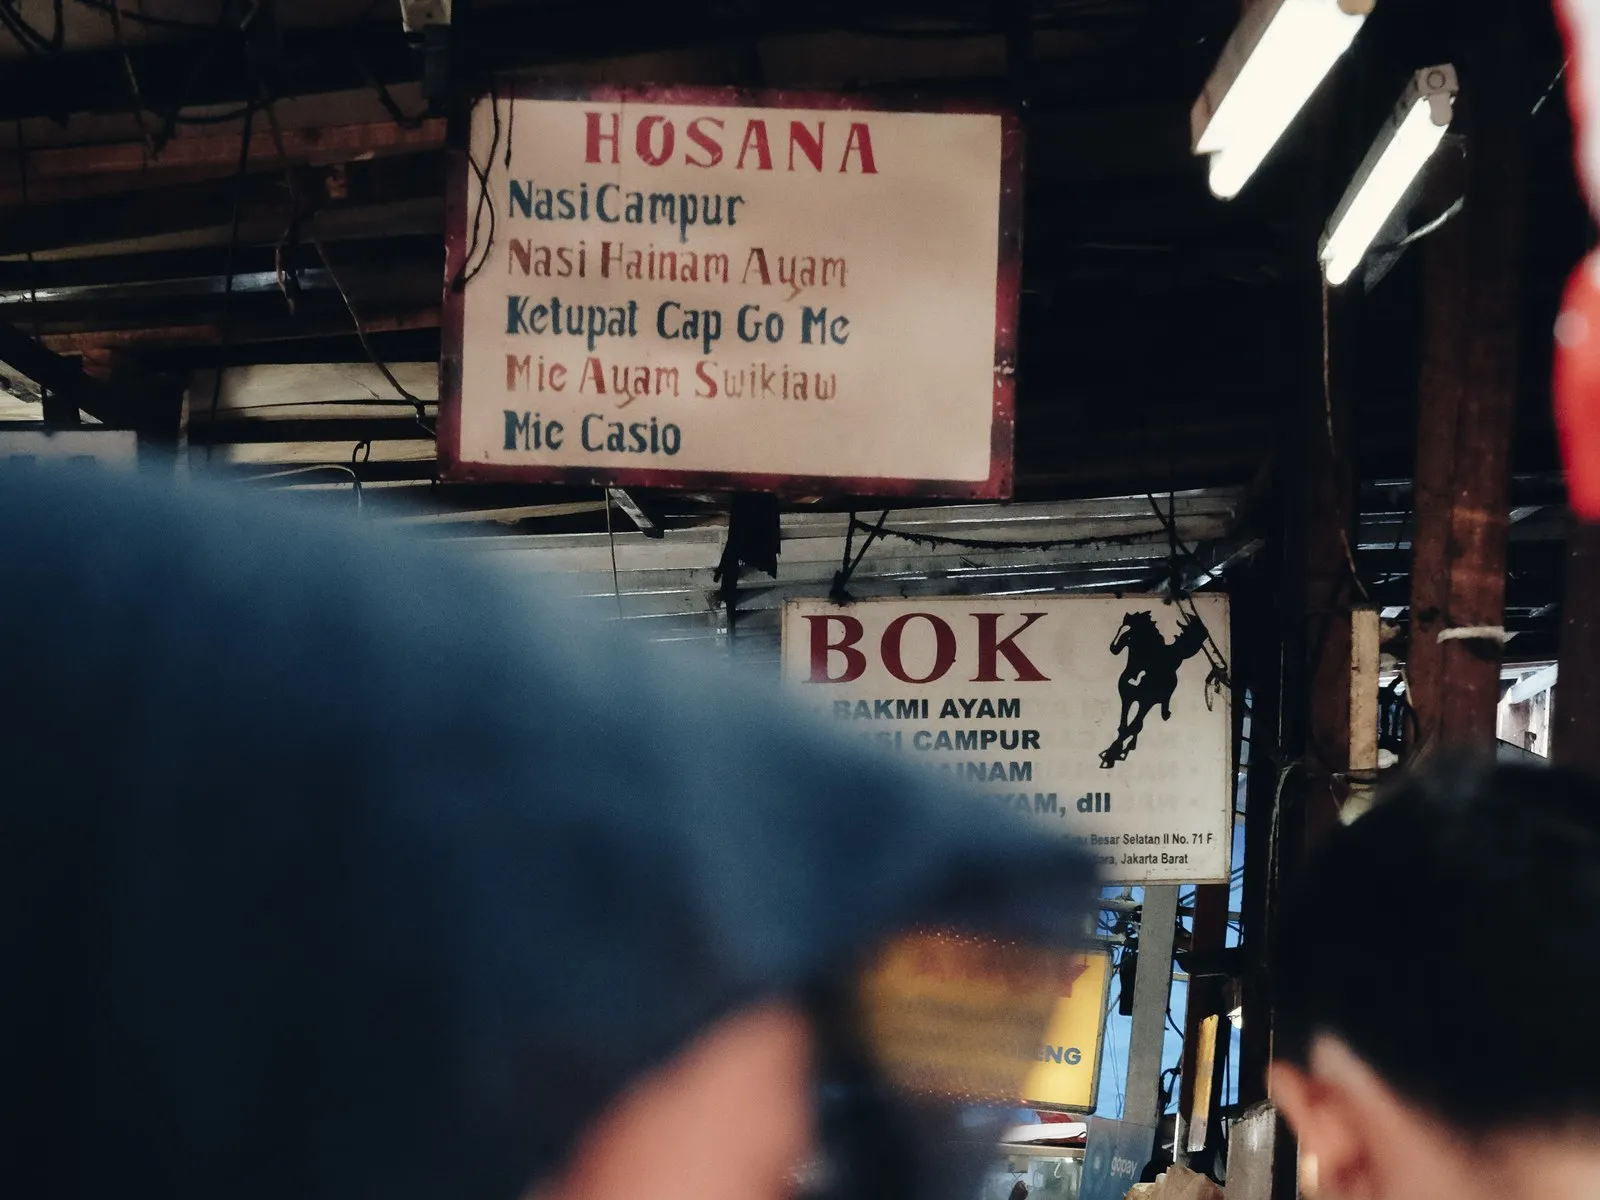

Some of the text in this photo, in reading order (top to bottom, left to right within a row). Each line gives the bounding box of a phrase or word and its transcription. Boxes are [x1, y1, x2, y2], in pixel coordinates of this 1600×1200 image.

[584, 112, 879, 174] HOSANA
[508, 179, 746, 243] Nasi Campur
[508, 238, 847, 301] Nasi Hainam Ayam
[505, 295, 850, 355] Ketupat Cap Go Me
[506, 354, 837, 409] Mie Ayam Swikiaw
[503, 409, 681, 455] Mie Casio
[801, 612, 1051, 684] BOK
[833, 697, 1021, 720] BAKMI AYAM
[913, 729, 1040, 751] CAMPUR
[1091, 834, 1120, 845] Besar
[1123, 834, 1160, 845] Selatan
[1172, 833, 1188, 844] No.
[1192, 833, 1203, 844] 71
[1206, 833, 1212, 844] F
[1121, 854, 1158, 864] Jakarta
[1161, 853, 1188, 864] Barat
[1111, 1157, 1138, 1180] gopay
